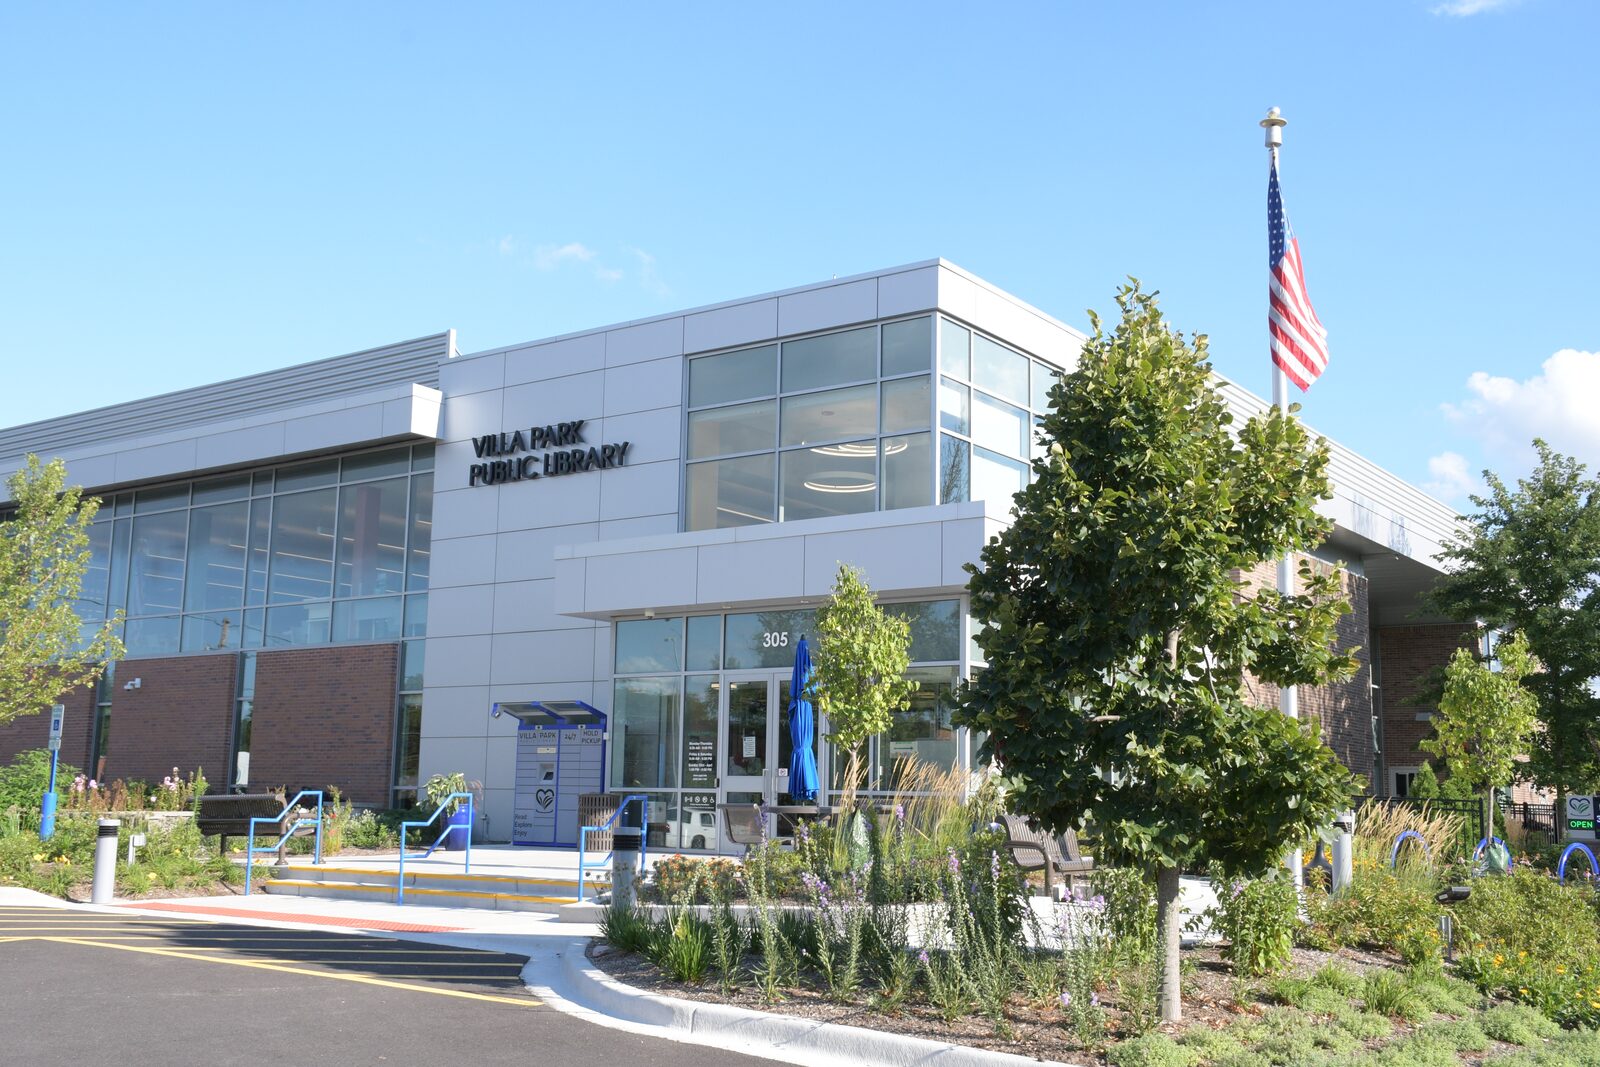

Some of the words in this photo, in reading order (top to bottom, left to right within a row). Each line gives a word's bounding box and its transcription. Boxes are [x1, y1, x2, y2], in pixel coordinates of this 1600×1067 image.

[472, 430, 526, 458] VILLA
[530, 420, 585, 450] PARK
[469, 455, 540, 486] PUBLIC
[543, 441, 630, 476] LIBRARY
[763, 632, 788, 647] 305
